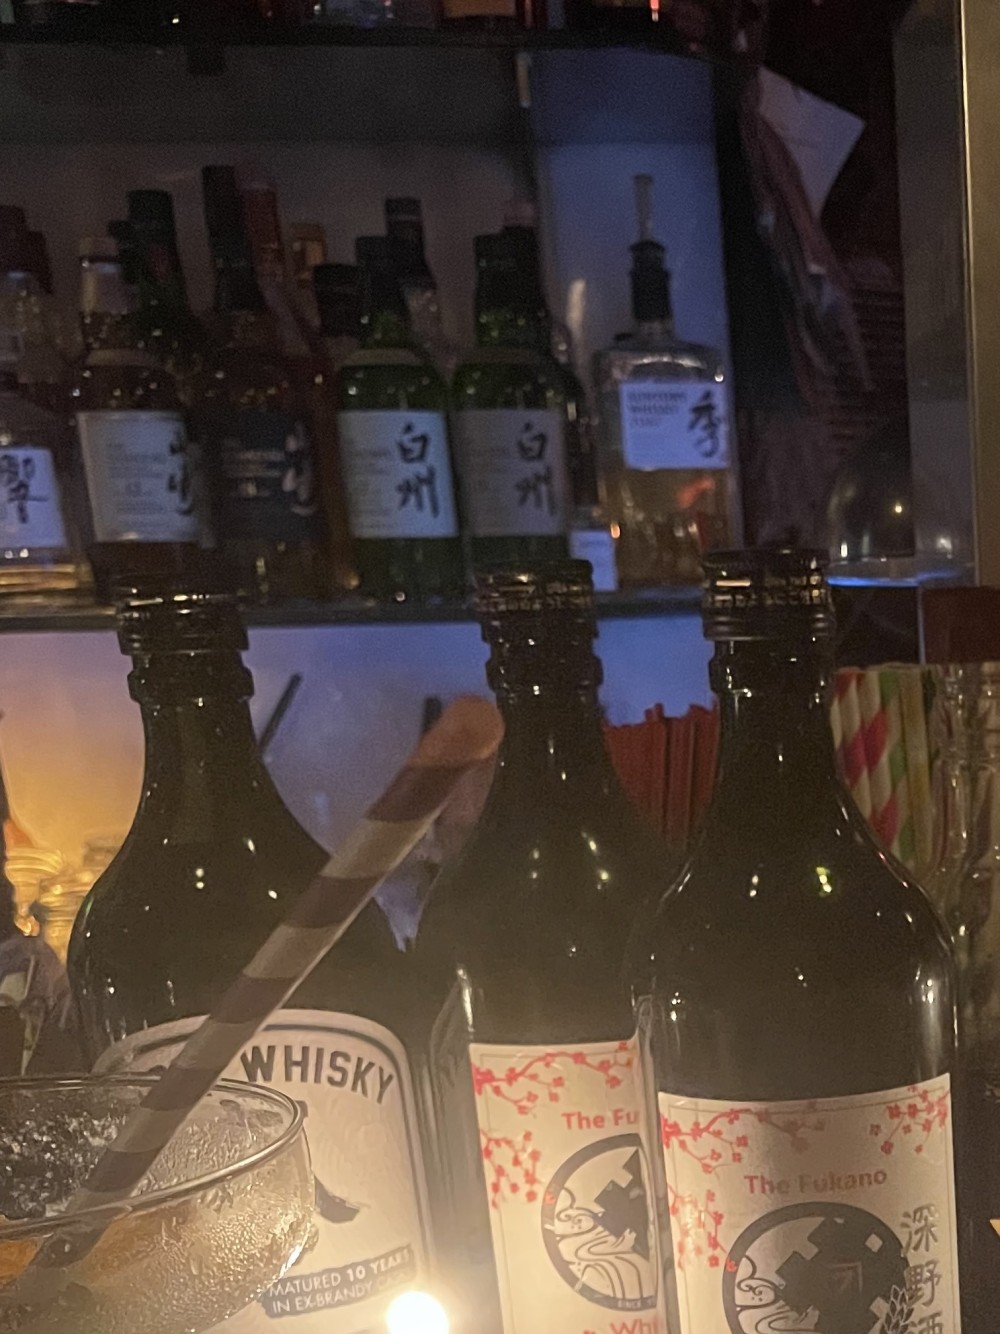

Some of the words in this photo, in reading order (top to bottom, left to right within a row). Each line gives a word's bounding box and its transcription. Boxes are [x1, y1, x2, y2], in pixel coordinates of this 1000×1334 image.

[396, 423, 439, 519] 白州
[515, 422, 556, 517] 白州
[239, 1044, 395, 1104] WHISKY
[562, 1111, 605, 1131] The
[743, 1174, 791, 1195] The
[798, 1169, 888, 1195] Fukano
[268, 1273, 342, 1298] MATURED
[346, 1267, 367, 1283] 10
[272, 1299, 292, 1314] IN
